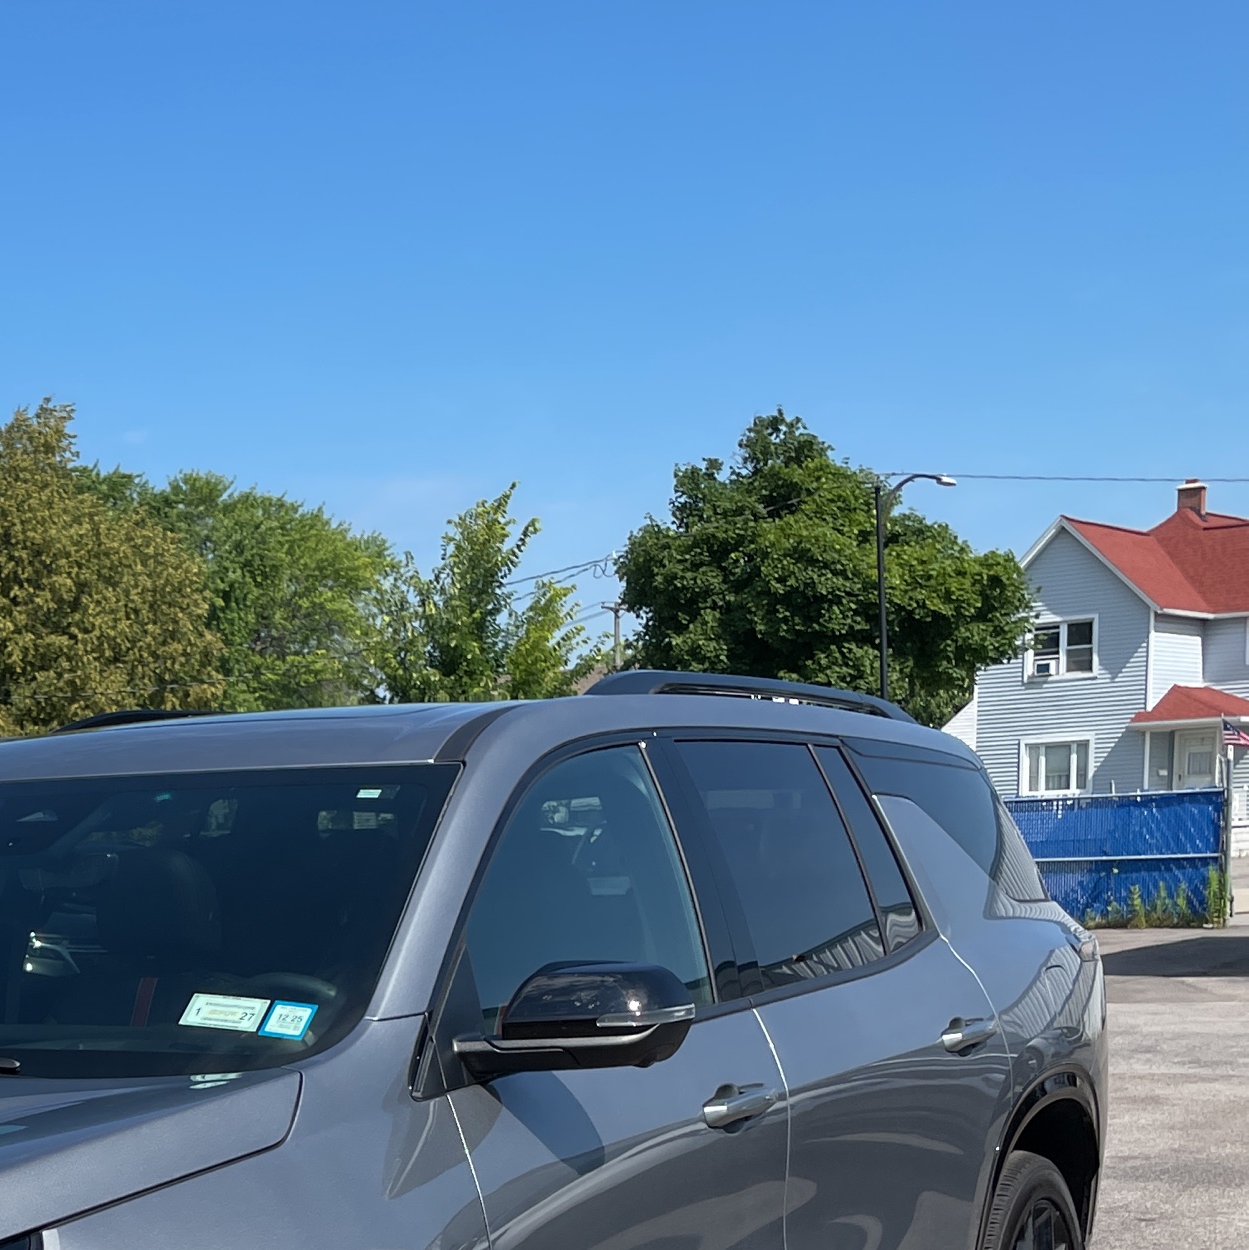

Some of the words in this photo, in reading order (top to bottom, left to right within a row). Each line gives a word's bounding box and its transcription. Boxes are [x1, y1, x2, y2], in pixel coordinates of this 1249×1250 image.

[239, 1012, 255, 1022] 27
[277, 1013, 288, 1022] 12
[291, 1014, 303, 1023] 25
